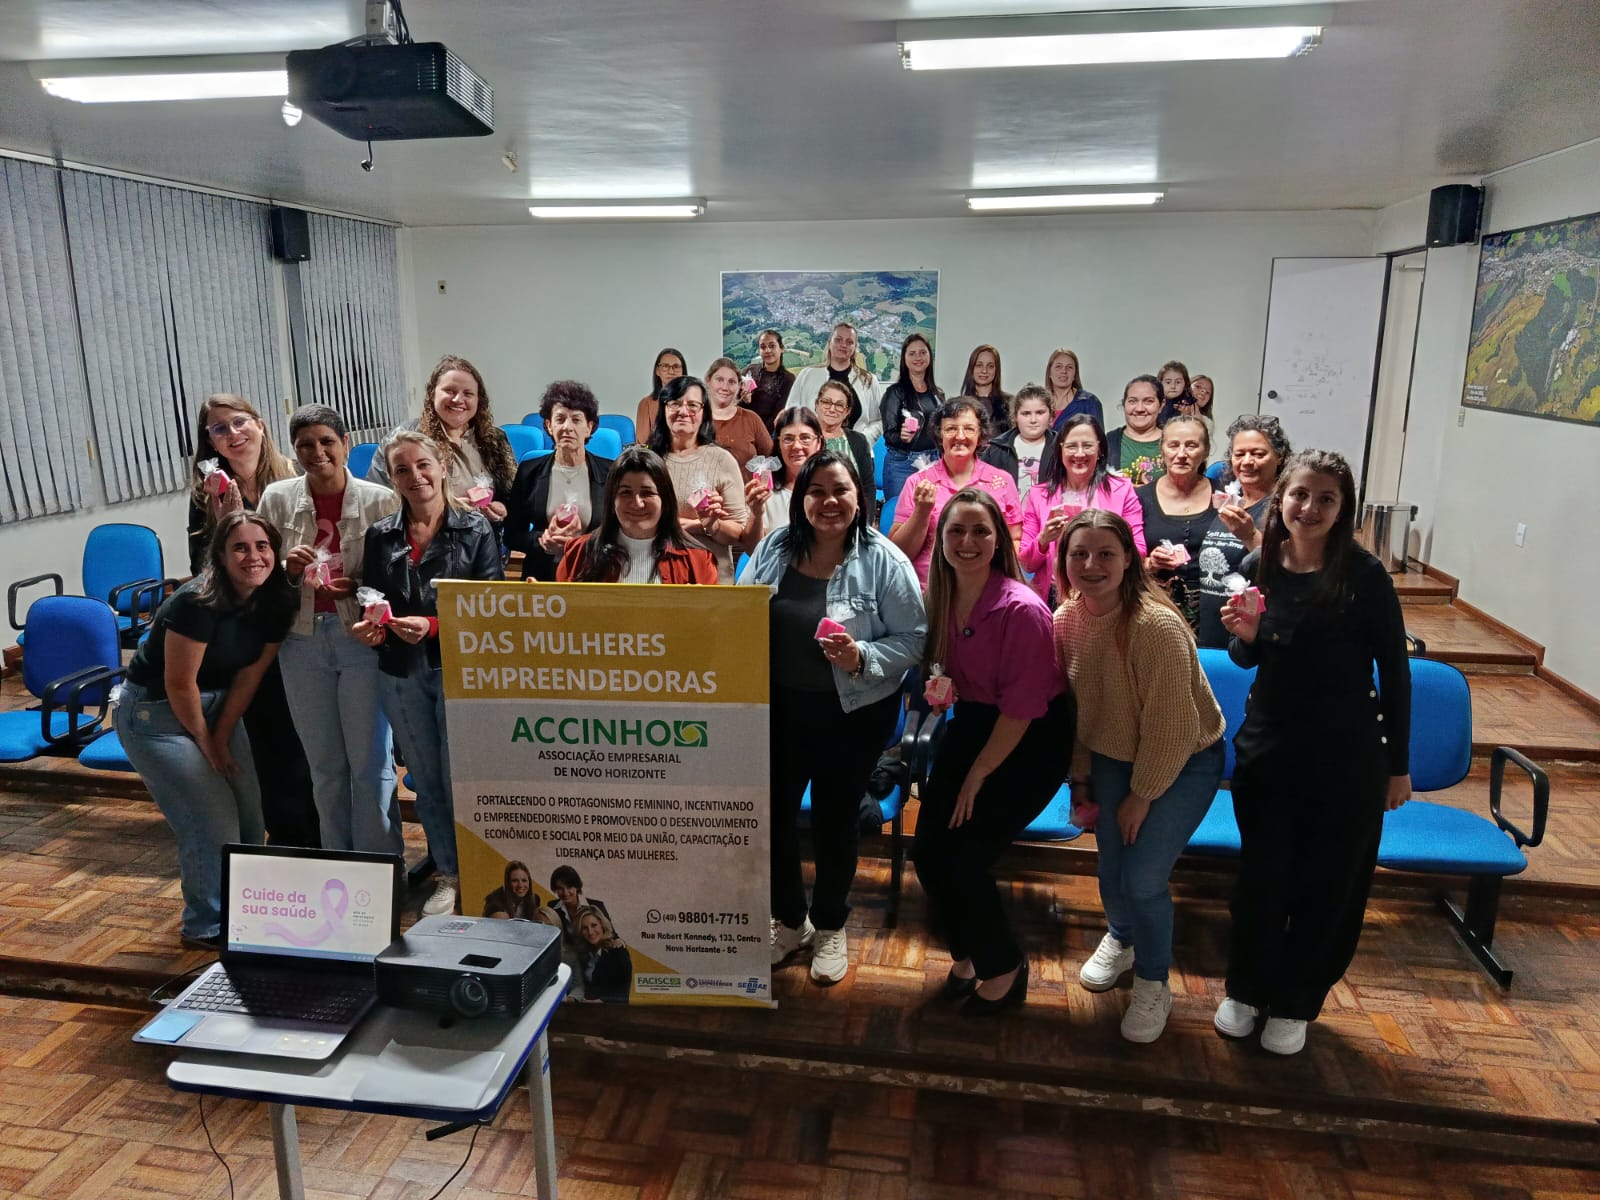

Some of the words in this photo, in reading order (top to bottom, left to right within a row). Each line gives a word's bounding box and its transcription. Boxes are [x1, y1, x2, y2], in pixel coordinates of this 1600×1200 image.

[456, 588, 566, 618] NÚCLEO
[460, 632, 514, 654] DAS
[524, 632, 666, 656] MULHERES
[462, 668, 717, 694] EMPREENDEDORAS
[511, 717, 672, 746] ACCINHO
[538, 749, 605, 763] ASSOCIAÇÃO
[608, 752, 682, 764] EMPRESARIAL
[554, 767, 567, 777] DE
[570, 767, 602, 778] NOVO
[605, 768, 667, 779] HORIZONTE
[477, 795, 546, 807] FORTALECENDO
[549, 797, 555, 807] O
[558, 797, 631, 809] PROTAGONISMO
[634, 799, 682, 811] FEMININO,
[685, 800, 754, 811] INCENTIVANDO
[474, 812, 481, 823] O
[484, 812, 581, 825] EMPREENDEDORISMO
[584, 815, 589, 825] E
[592, 816, 657, 827] PROMOVENDO
[660, 817, 667, 827] O
[670, 817, 758, 830] DESENVOLVIMENTO
[484, 827, 540, 840] ECONÔMICO
[543, 830, 547, 840] E
[550, 830, 581, 842] SOCIAL
[583, 832, 602, 842] POR
[604, 832, 628, 843] MEIO
[630, 833, 643, 843] DA
[645, 832, 677, 846] UNIÃO,
[680, 832, 742, 847] CAPACITAÇÃO
[744, 836, 749, 845] E
[556, 847, 605, 861] LIDERANÇA
[608, 849, 625, 859] DAS
[628, 850, 679, 861] MULHERES.
[242, 888, 284, 902] Cuide
[287, 891, 306, 904] da
[242, 904, 268, 915] sua
[272, 905, 317, 919] saúde
[678, 912, 748, 925] 98801-7715
[658, 932, 682, 940] Robert
[684, 933, 717, 943] Kennedy,
[736, 934, 761, 943] Centro
[686, 946, 720, 954] Horizonte
[727, 946, 737, 954] SC
